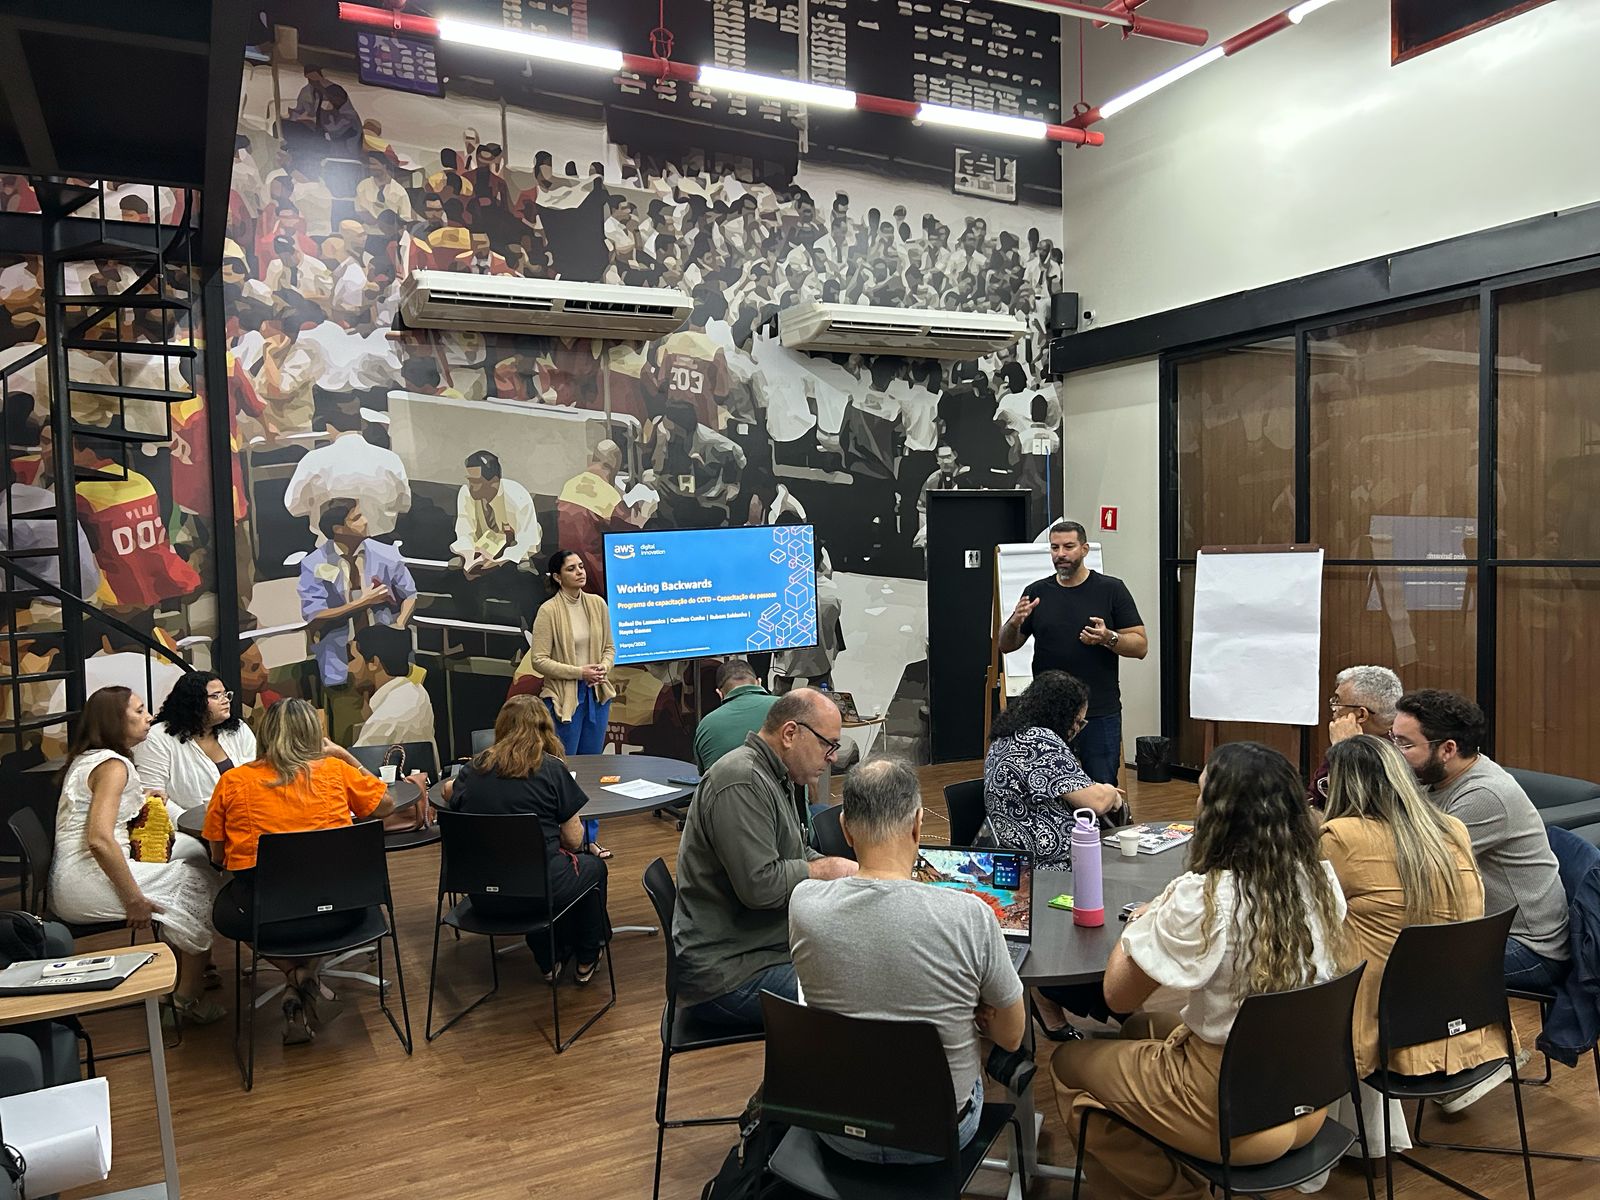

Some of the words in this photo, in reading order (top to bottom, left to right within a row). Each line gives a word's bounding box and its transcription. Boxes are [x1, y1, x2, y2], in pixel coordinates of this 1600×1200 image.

[614, 544, 635, 553] aws
[616, 583, 659, 594] Working
[661, 579, 713, 591] Backwards
[617, 601, 646, 609] Programa
[655, 598, 687, 607] capacitação
[717, 594, 748, 602] Capacitação
[757, 592, 777, 600] pessoas
